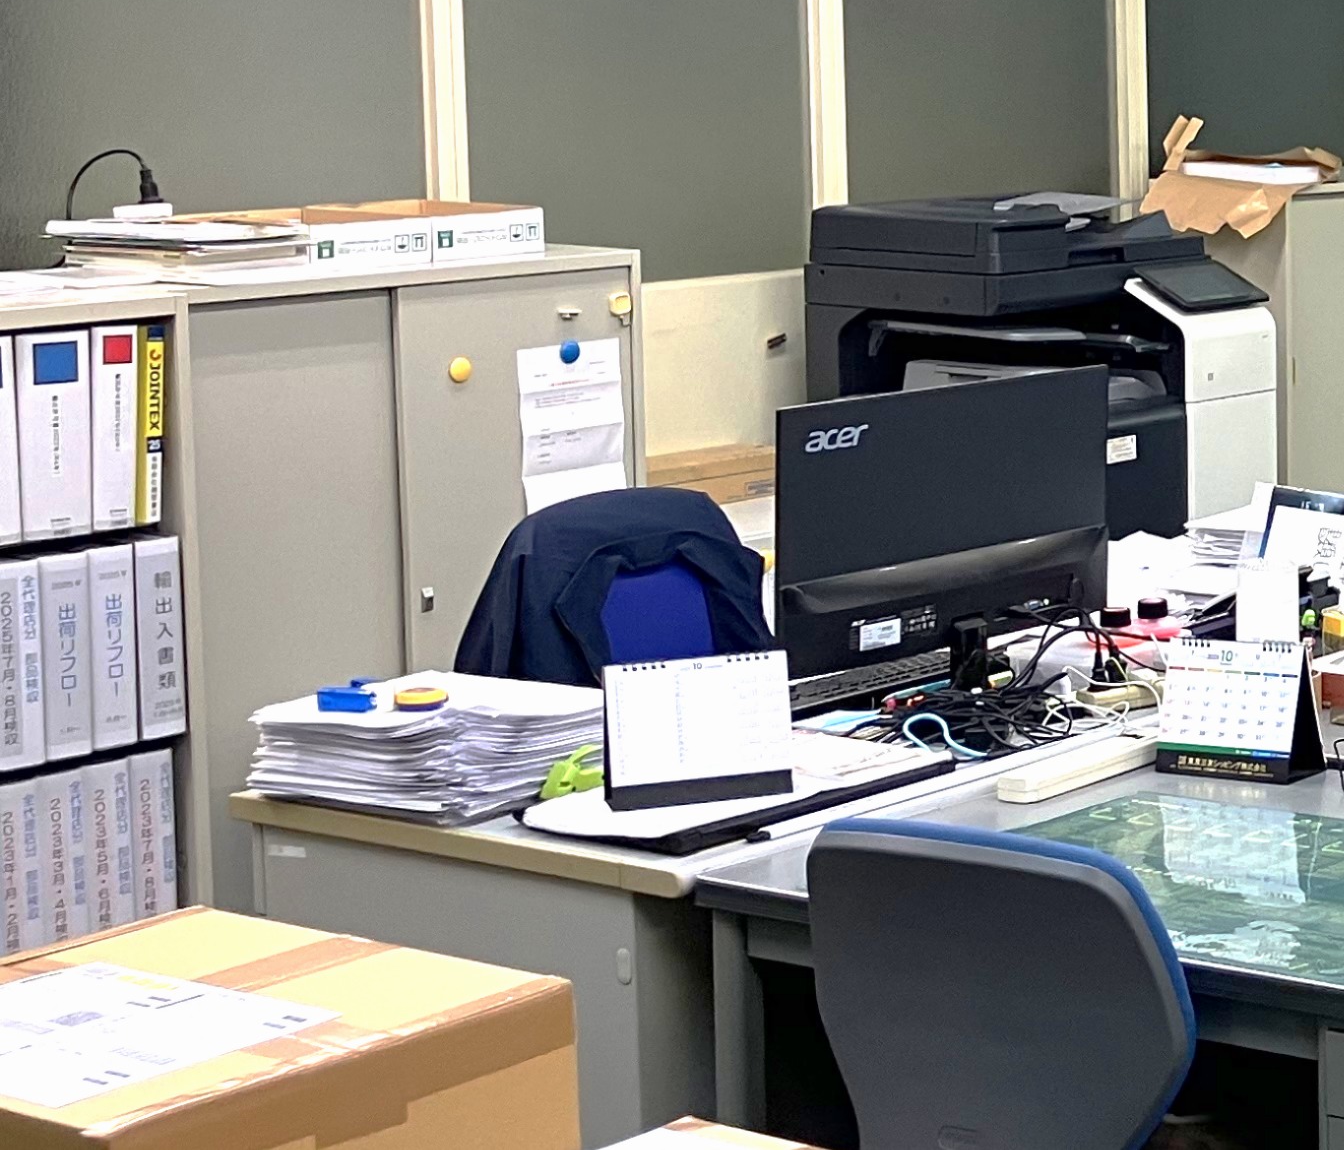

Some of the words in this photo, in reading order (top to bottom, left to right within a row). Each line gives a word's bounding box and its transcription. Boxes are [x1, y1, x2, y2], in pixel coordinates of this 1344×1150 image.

[149, 363, 162, 431] JOINTEX
[805, 423, 869, 452] acer
[58, 602, 77, 707] 出荷リフロー
[105, 593, 124, 698] 出荷リフロー
[692, 662, 703, 670] 10
[1220, 650, 1234, 662] 10
